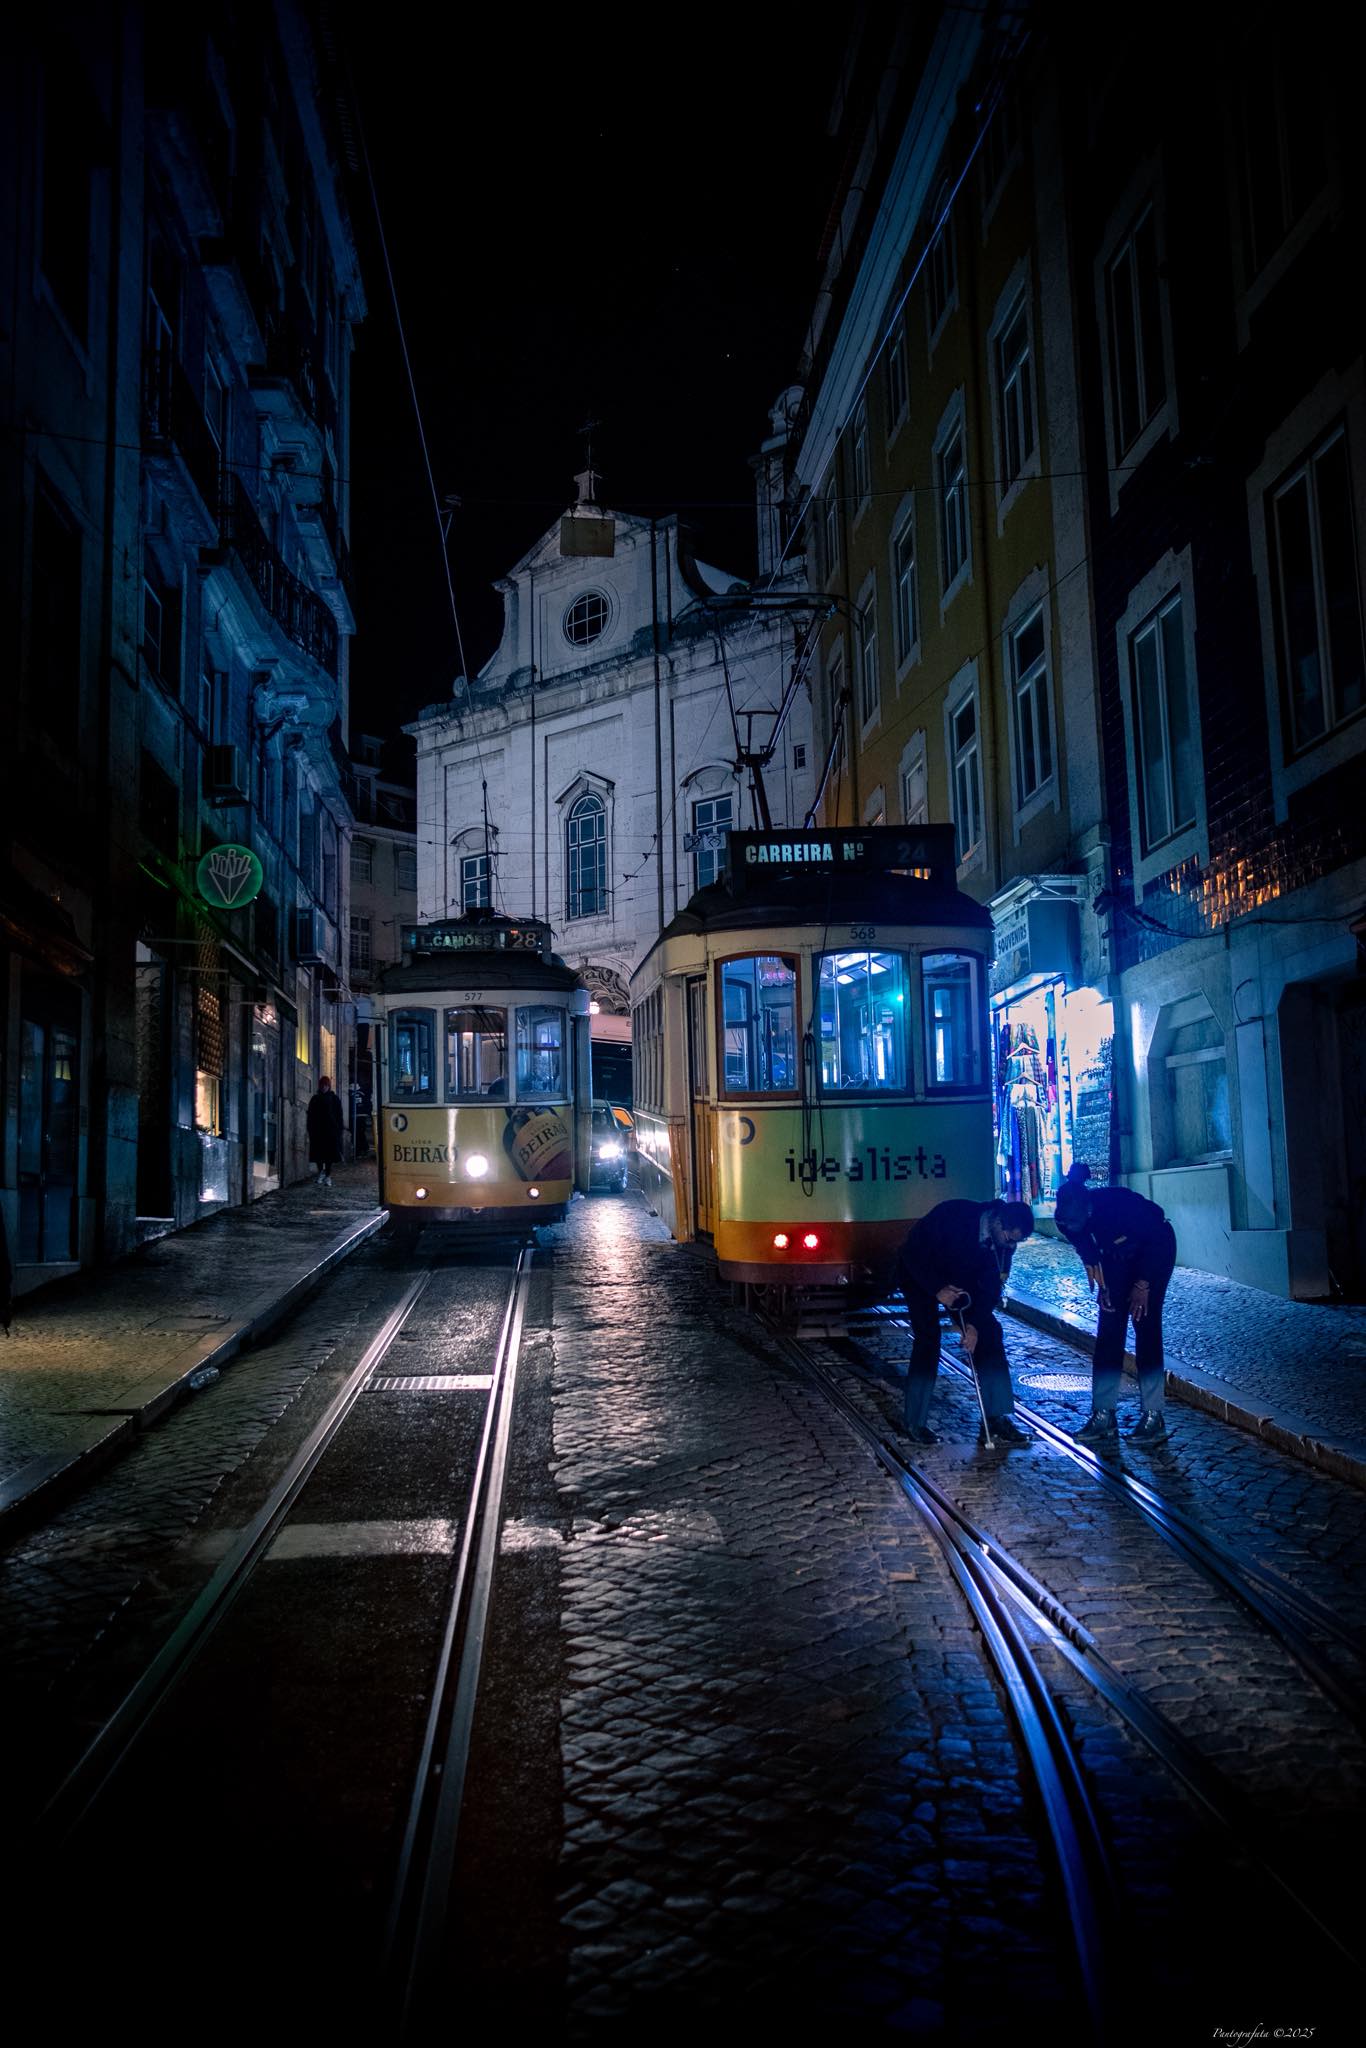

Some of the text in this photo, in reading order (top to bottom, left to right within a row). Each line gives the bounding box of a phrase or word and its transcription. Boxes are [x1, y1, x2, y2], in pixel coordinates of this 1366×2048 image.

[745, 843, 864, 863] CARREIRA Nº
[897, 842, 926, 863] 24
[512, 932, 537, 948] 28
[850, 927, 875, 940] 568
[998, 923, 1027, 955] SOUVENIRS
[465, 993, 482, 1001] 577
[393, 1143, 458, 1163] BEIRÃO
[785, 1146, 946, 1182] idealista
